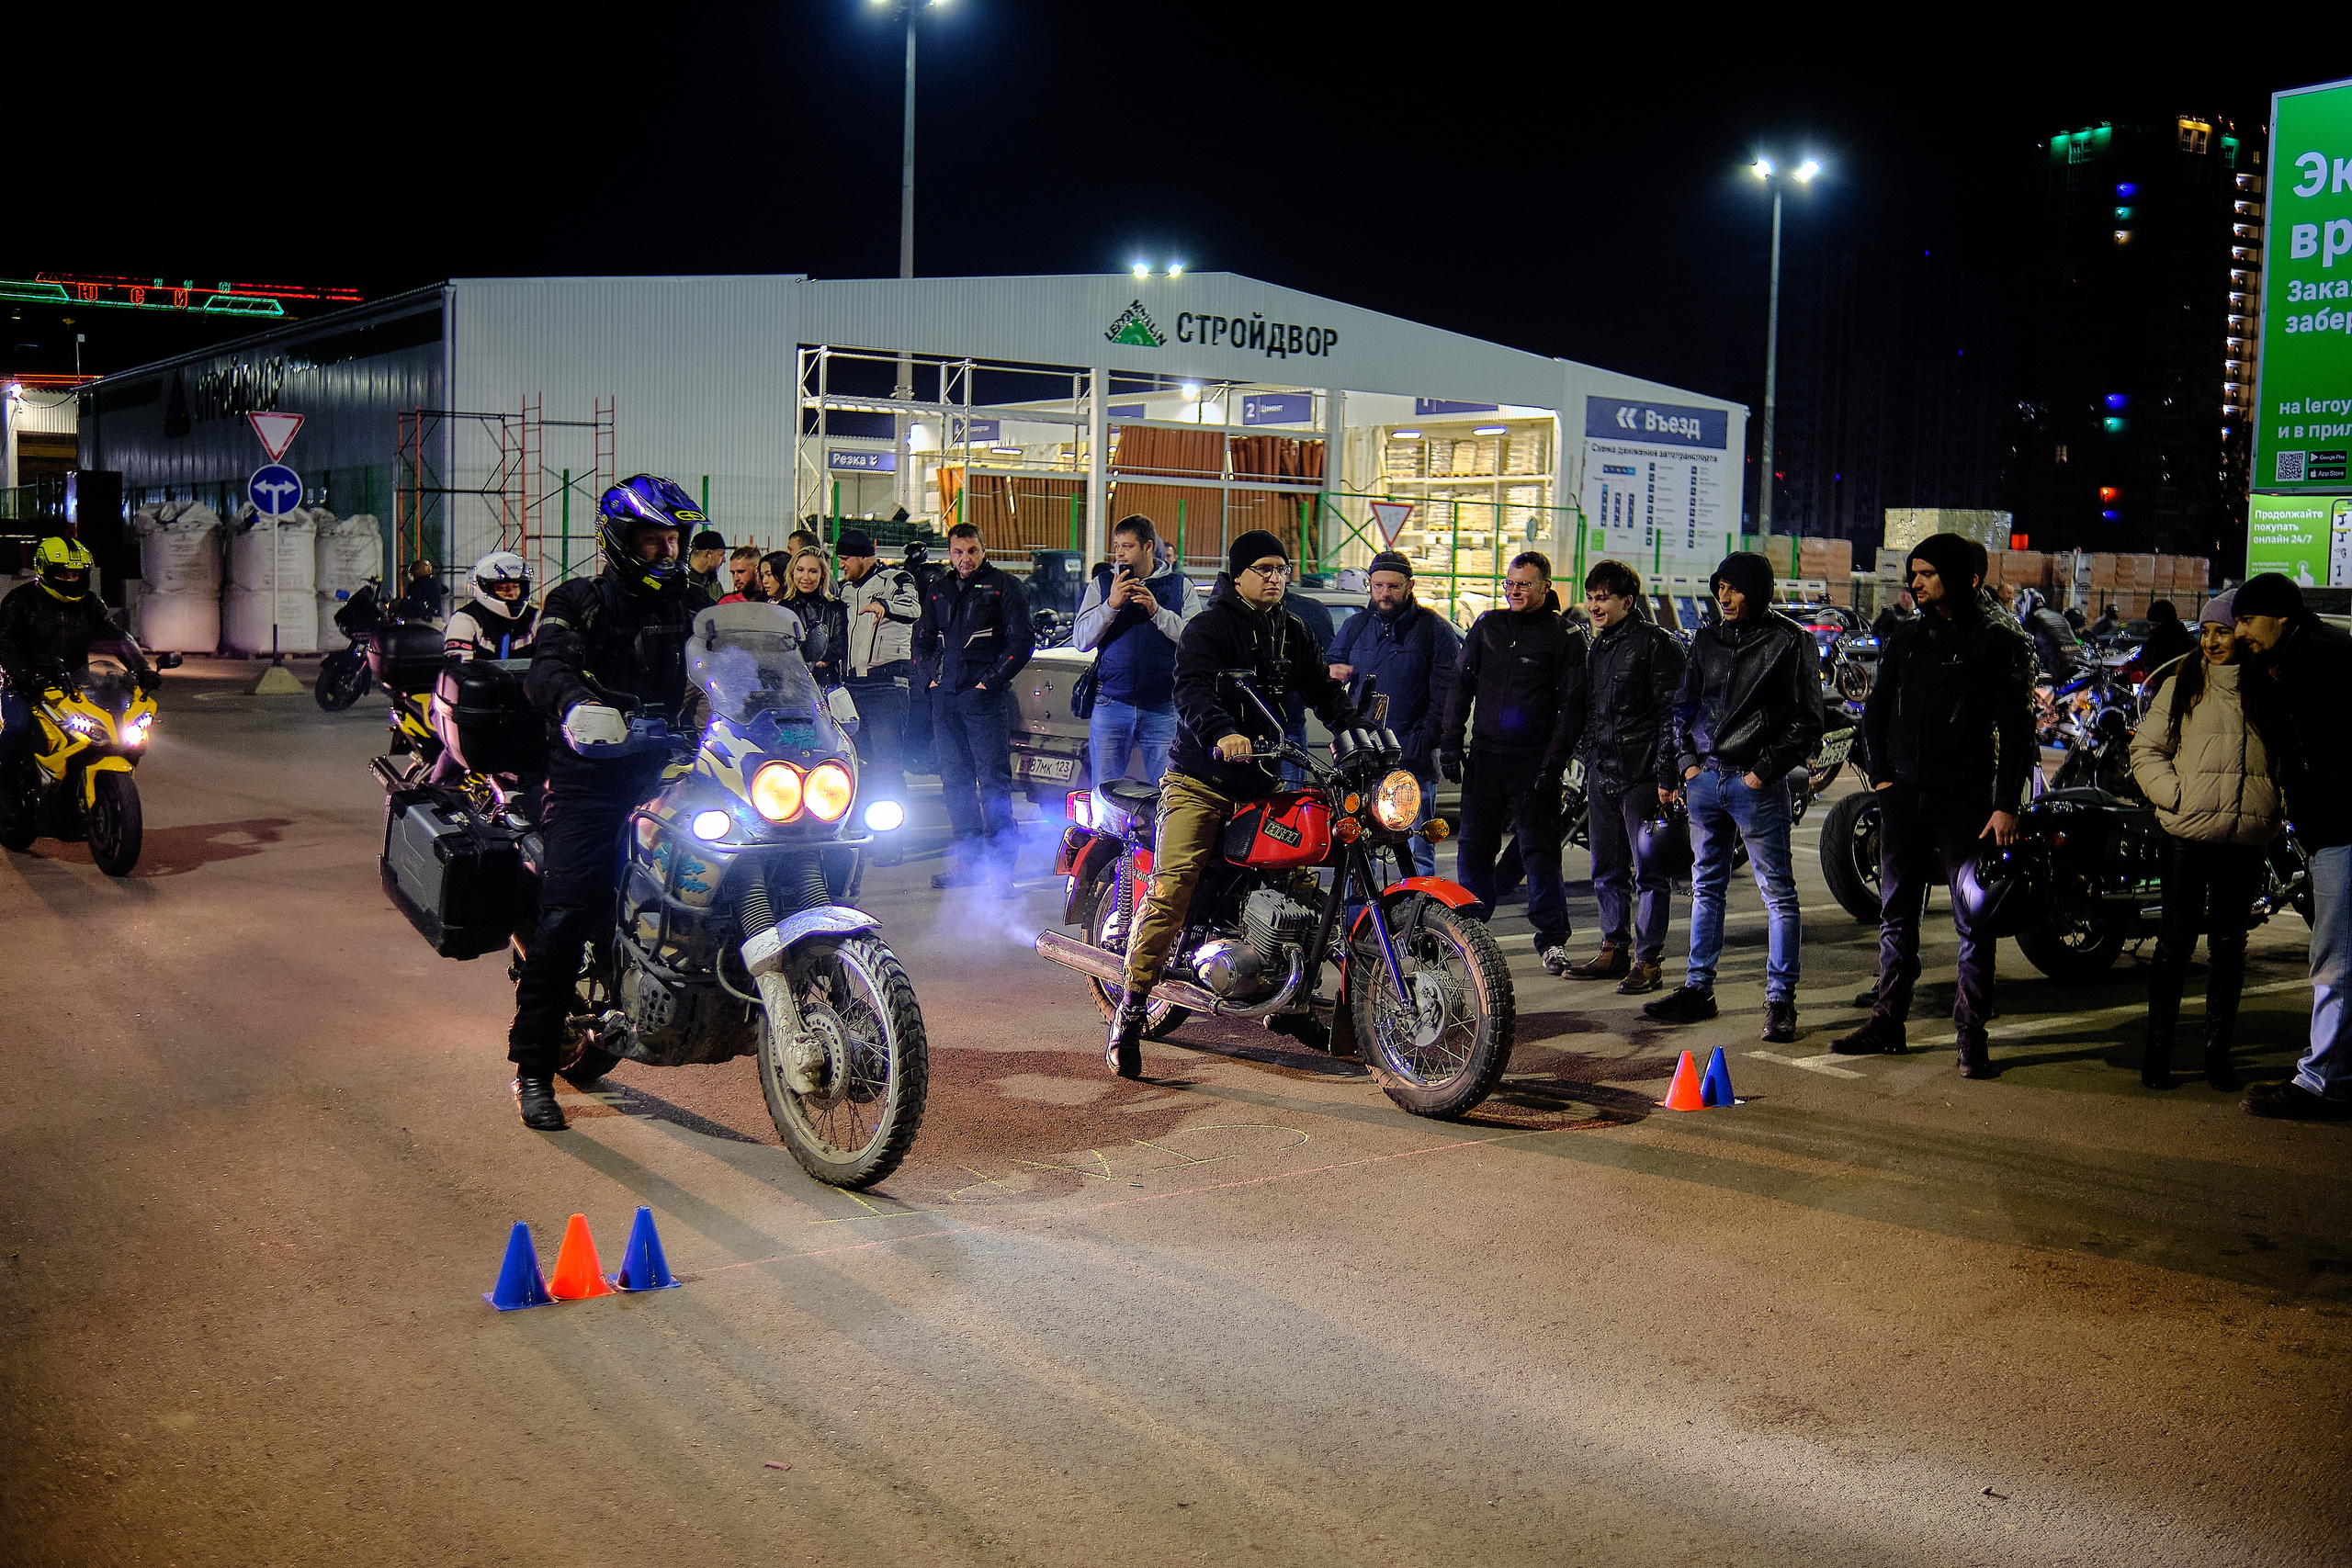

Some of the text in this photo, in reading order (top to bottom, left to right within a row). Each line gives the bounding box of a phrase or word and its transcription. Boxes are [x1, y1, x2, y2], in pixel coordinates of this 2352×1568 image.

[2287, 279, 2352, 302] Зака
[1104, 309, 1135, 341] LEROY
[1177, 311, 1338, 359] СТРОЙДВОР
[1246, 402, 1256, 418] 2
[2279, 401, 2301, 414] на
[1645, 409, 1701, 441] Въезд
[2278, 426, 2290, 438] и
[2293, 425, 2304, 438] в
[832, 453, 866, 467] Резка
[2255, 509, 2324, 521] Продолжайте
[2254, 524, 2299, 533] покупать
[2253, 534, 2312, 544] онлайн 24/7
[1055, 760, 1070, 772] 123
